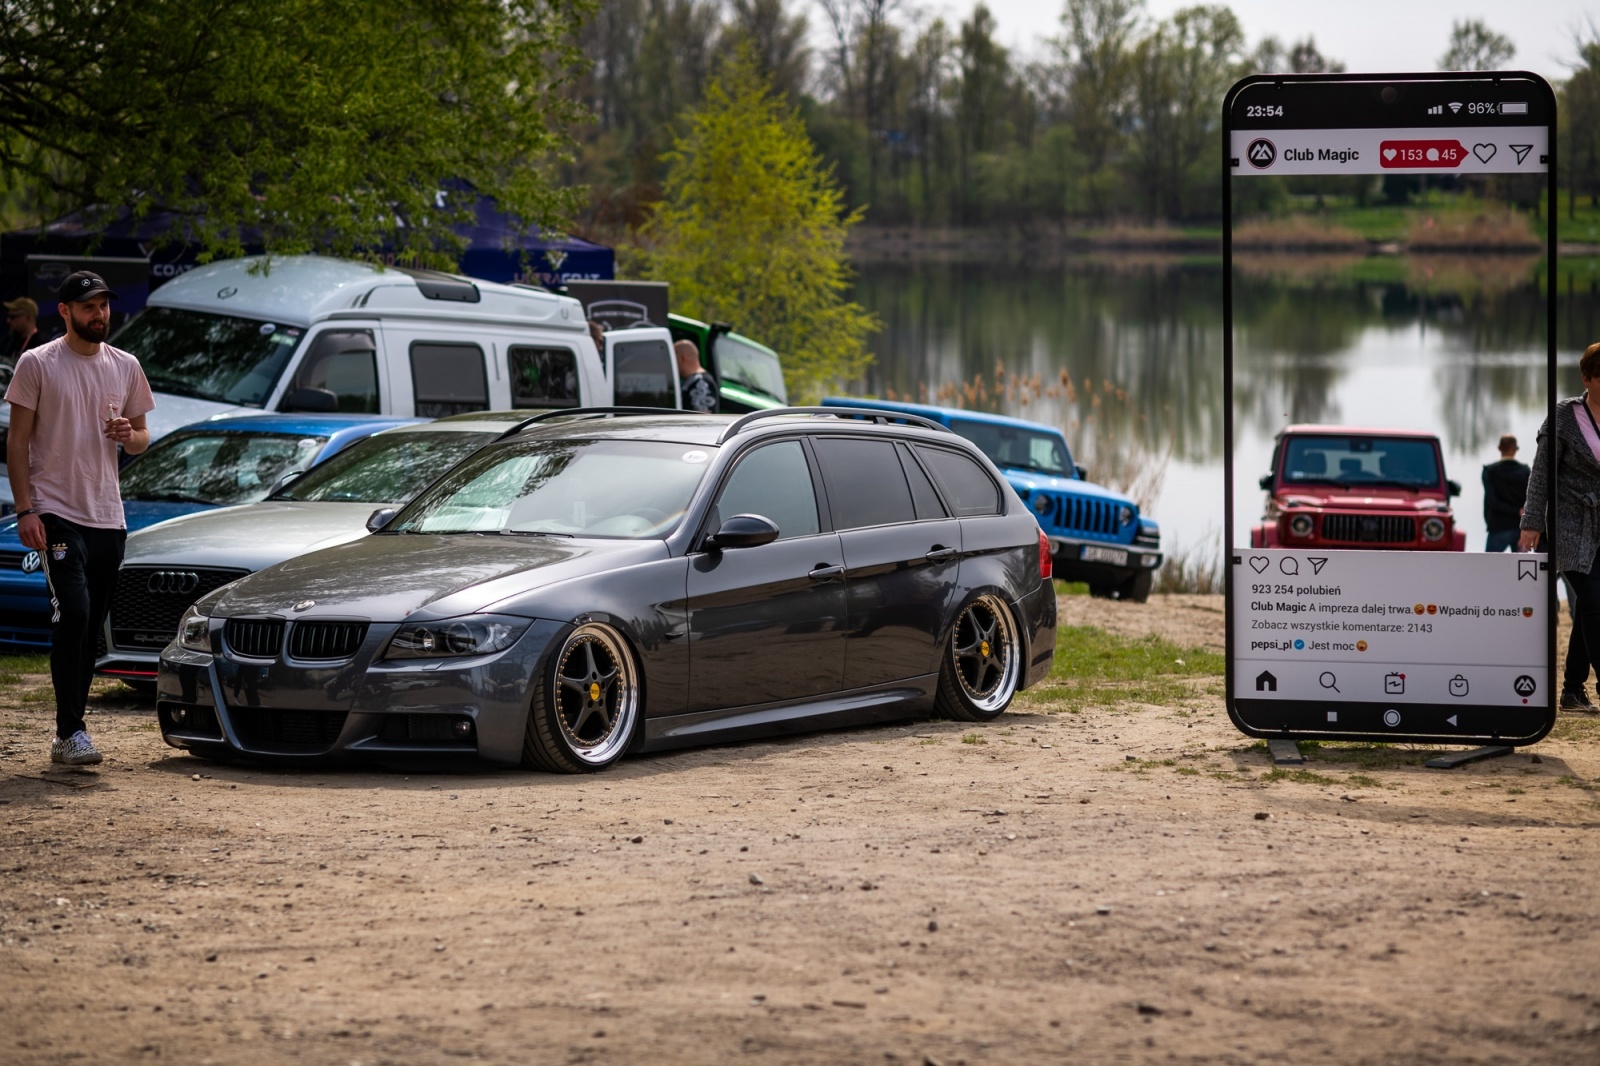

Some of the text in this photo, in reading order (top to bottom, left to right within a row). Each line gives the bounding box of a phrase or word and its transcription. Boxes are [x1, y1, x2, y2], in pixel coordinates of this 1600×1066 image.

[1246, 102, 1495, 117] 23:54 96%
[1284, 148, 1457, 164] Club Magic 153 45
[1252, 584, 1341, 596] 923 254 polubień
[1251, 602, 1520, 618] Club Magic A impreza dalej trwa. Wpadnij do nas!
[1251, 620, 1433, 633] Zobacz wszystkie komentarze: 2143
[1251, 639, 1292, 651] pepsi_pl
[1308, 641, 1330, 650] Jest
